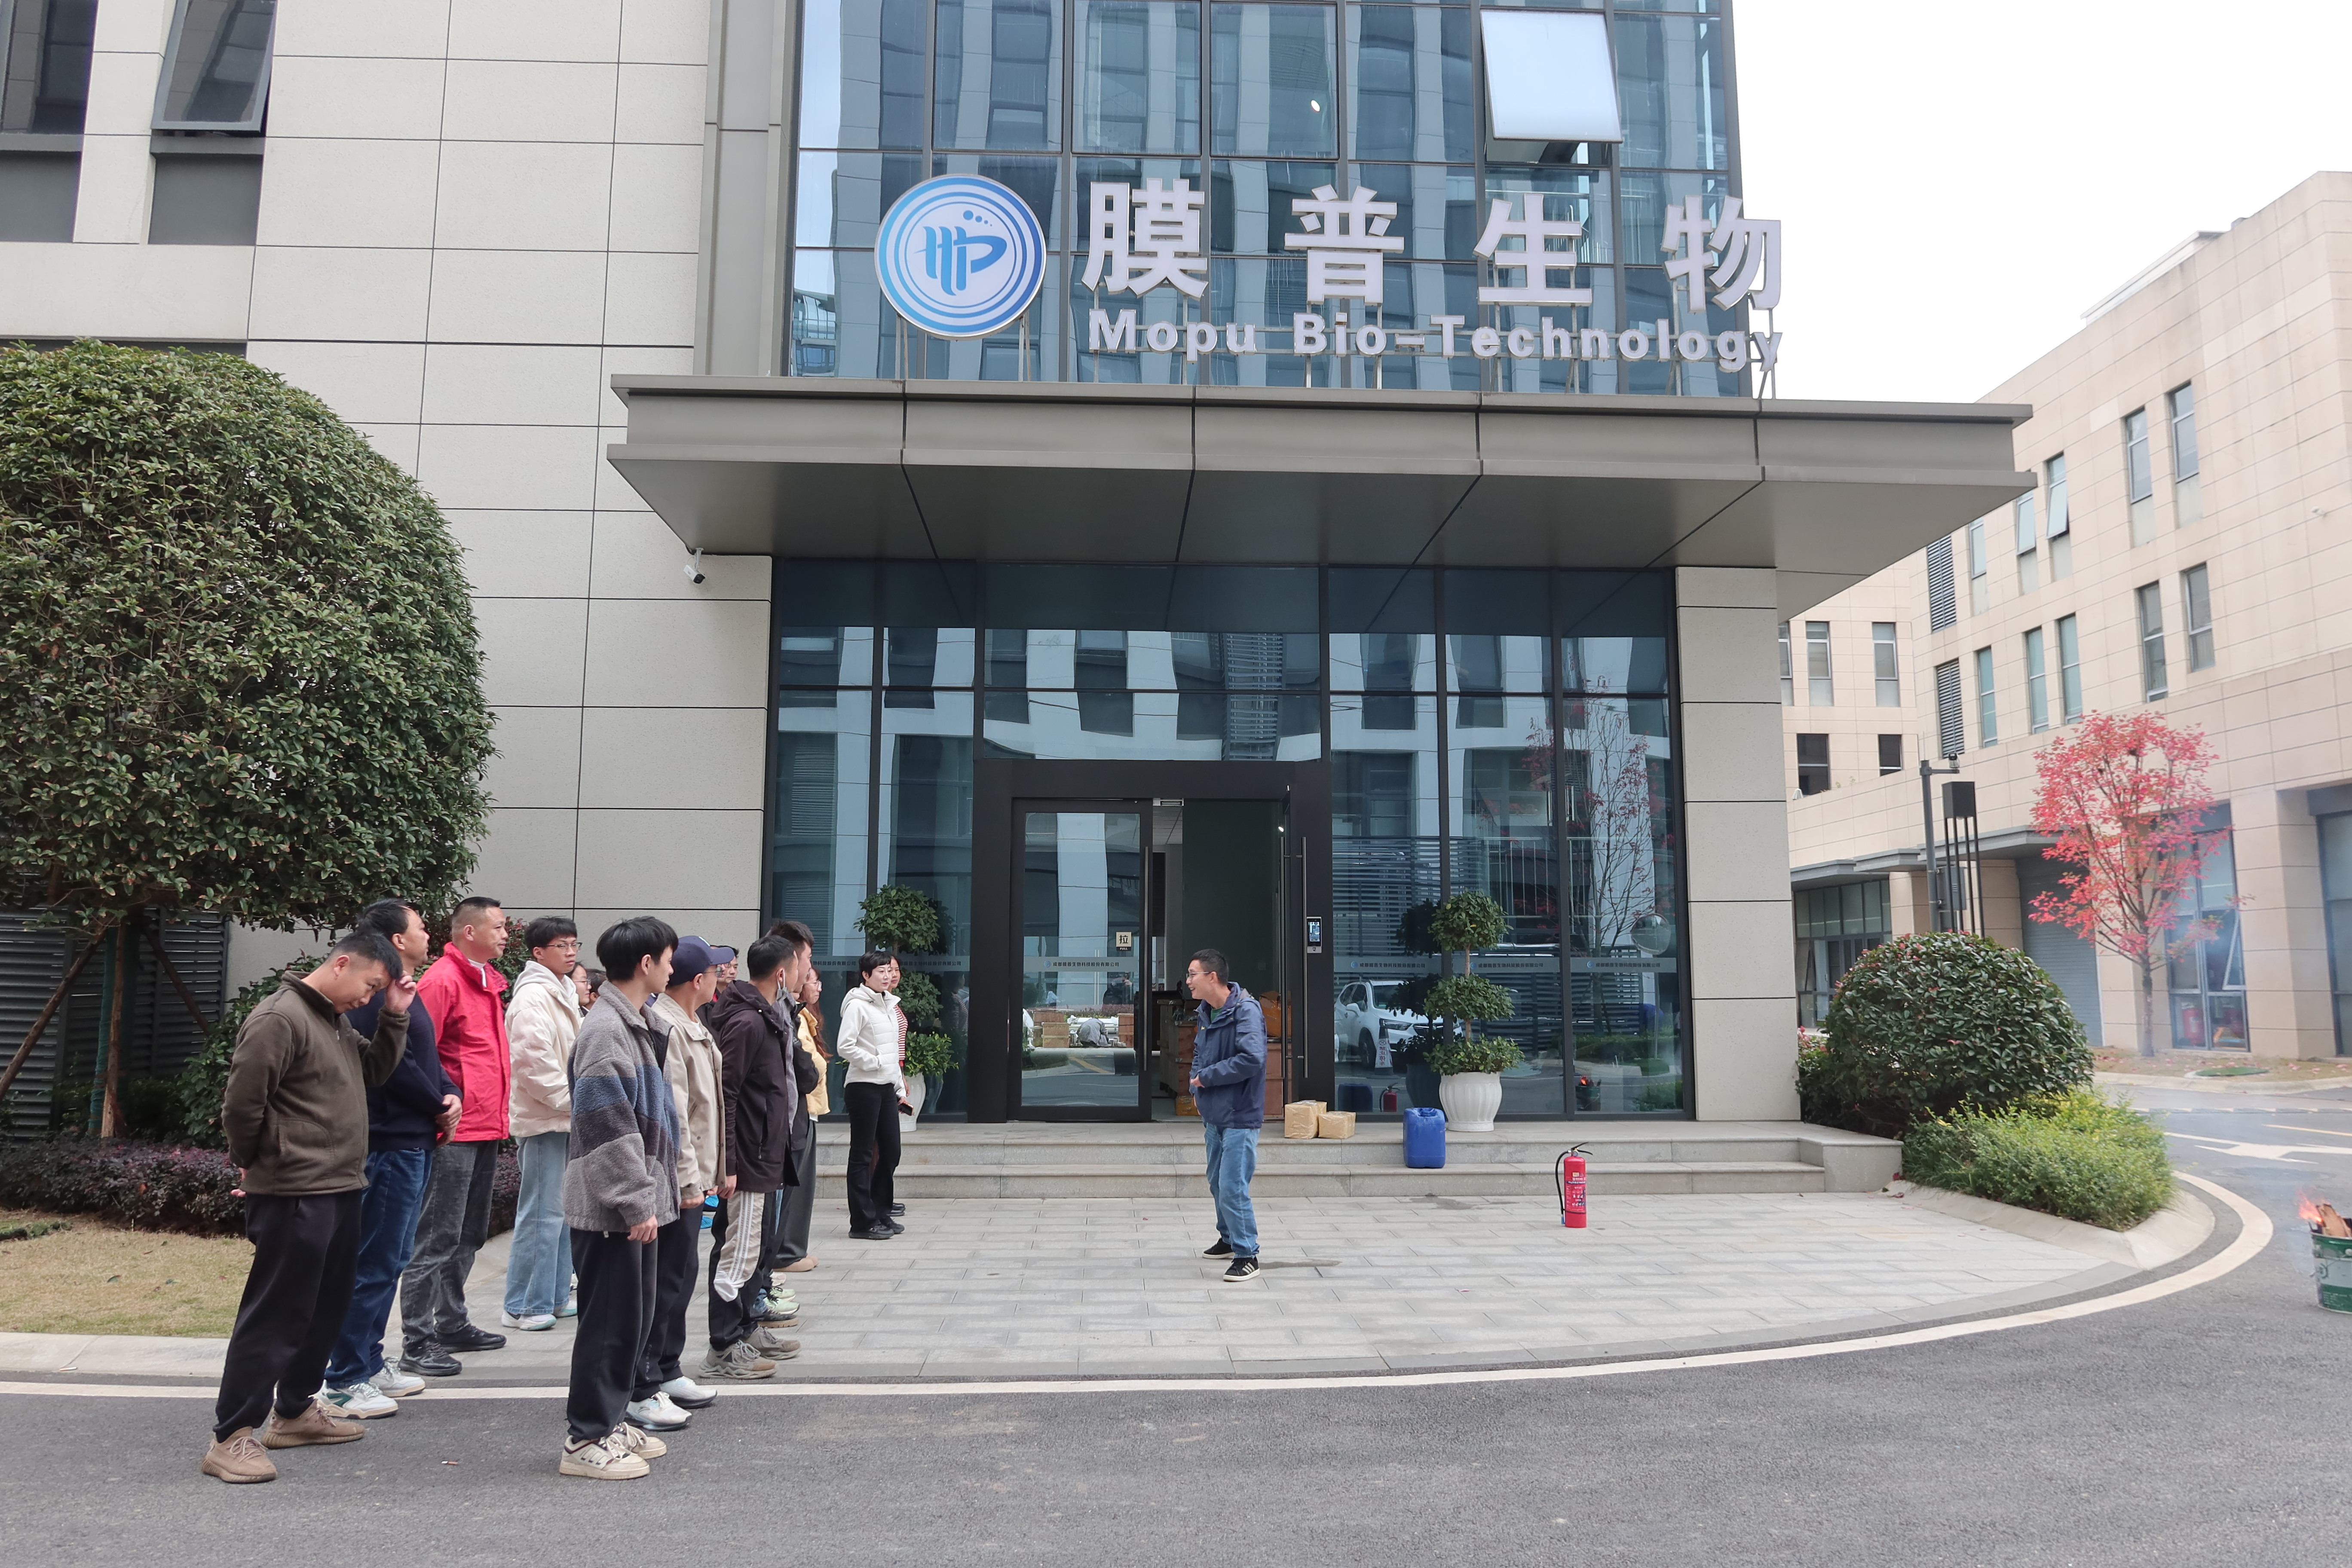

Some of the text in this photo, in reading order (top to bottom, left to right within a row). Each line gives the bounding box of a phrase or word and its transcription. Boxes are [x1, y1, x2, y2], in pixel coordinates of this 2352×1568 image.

[1081, 179, 1782, 314] 膜普生物
[1088, 309, 1783, 373] Mopu Bio-Technology
[1119, 934, 1128, 944] 拉
